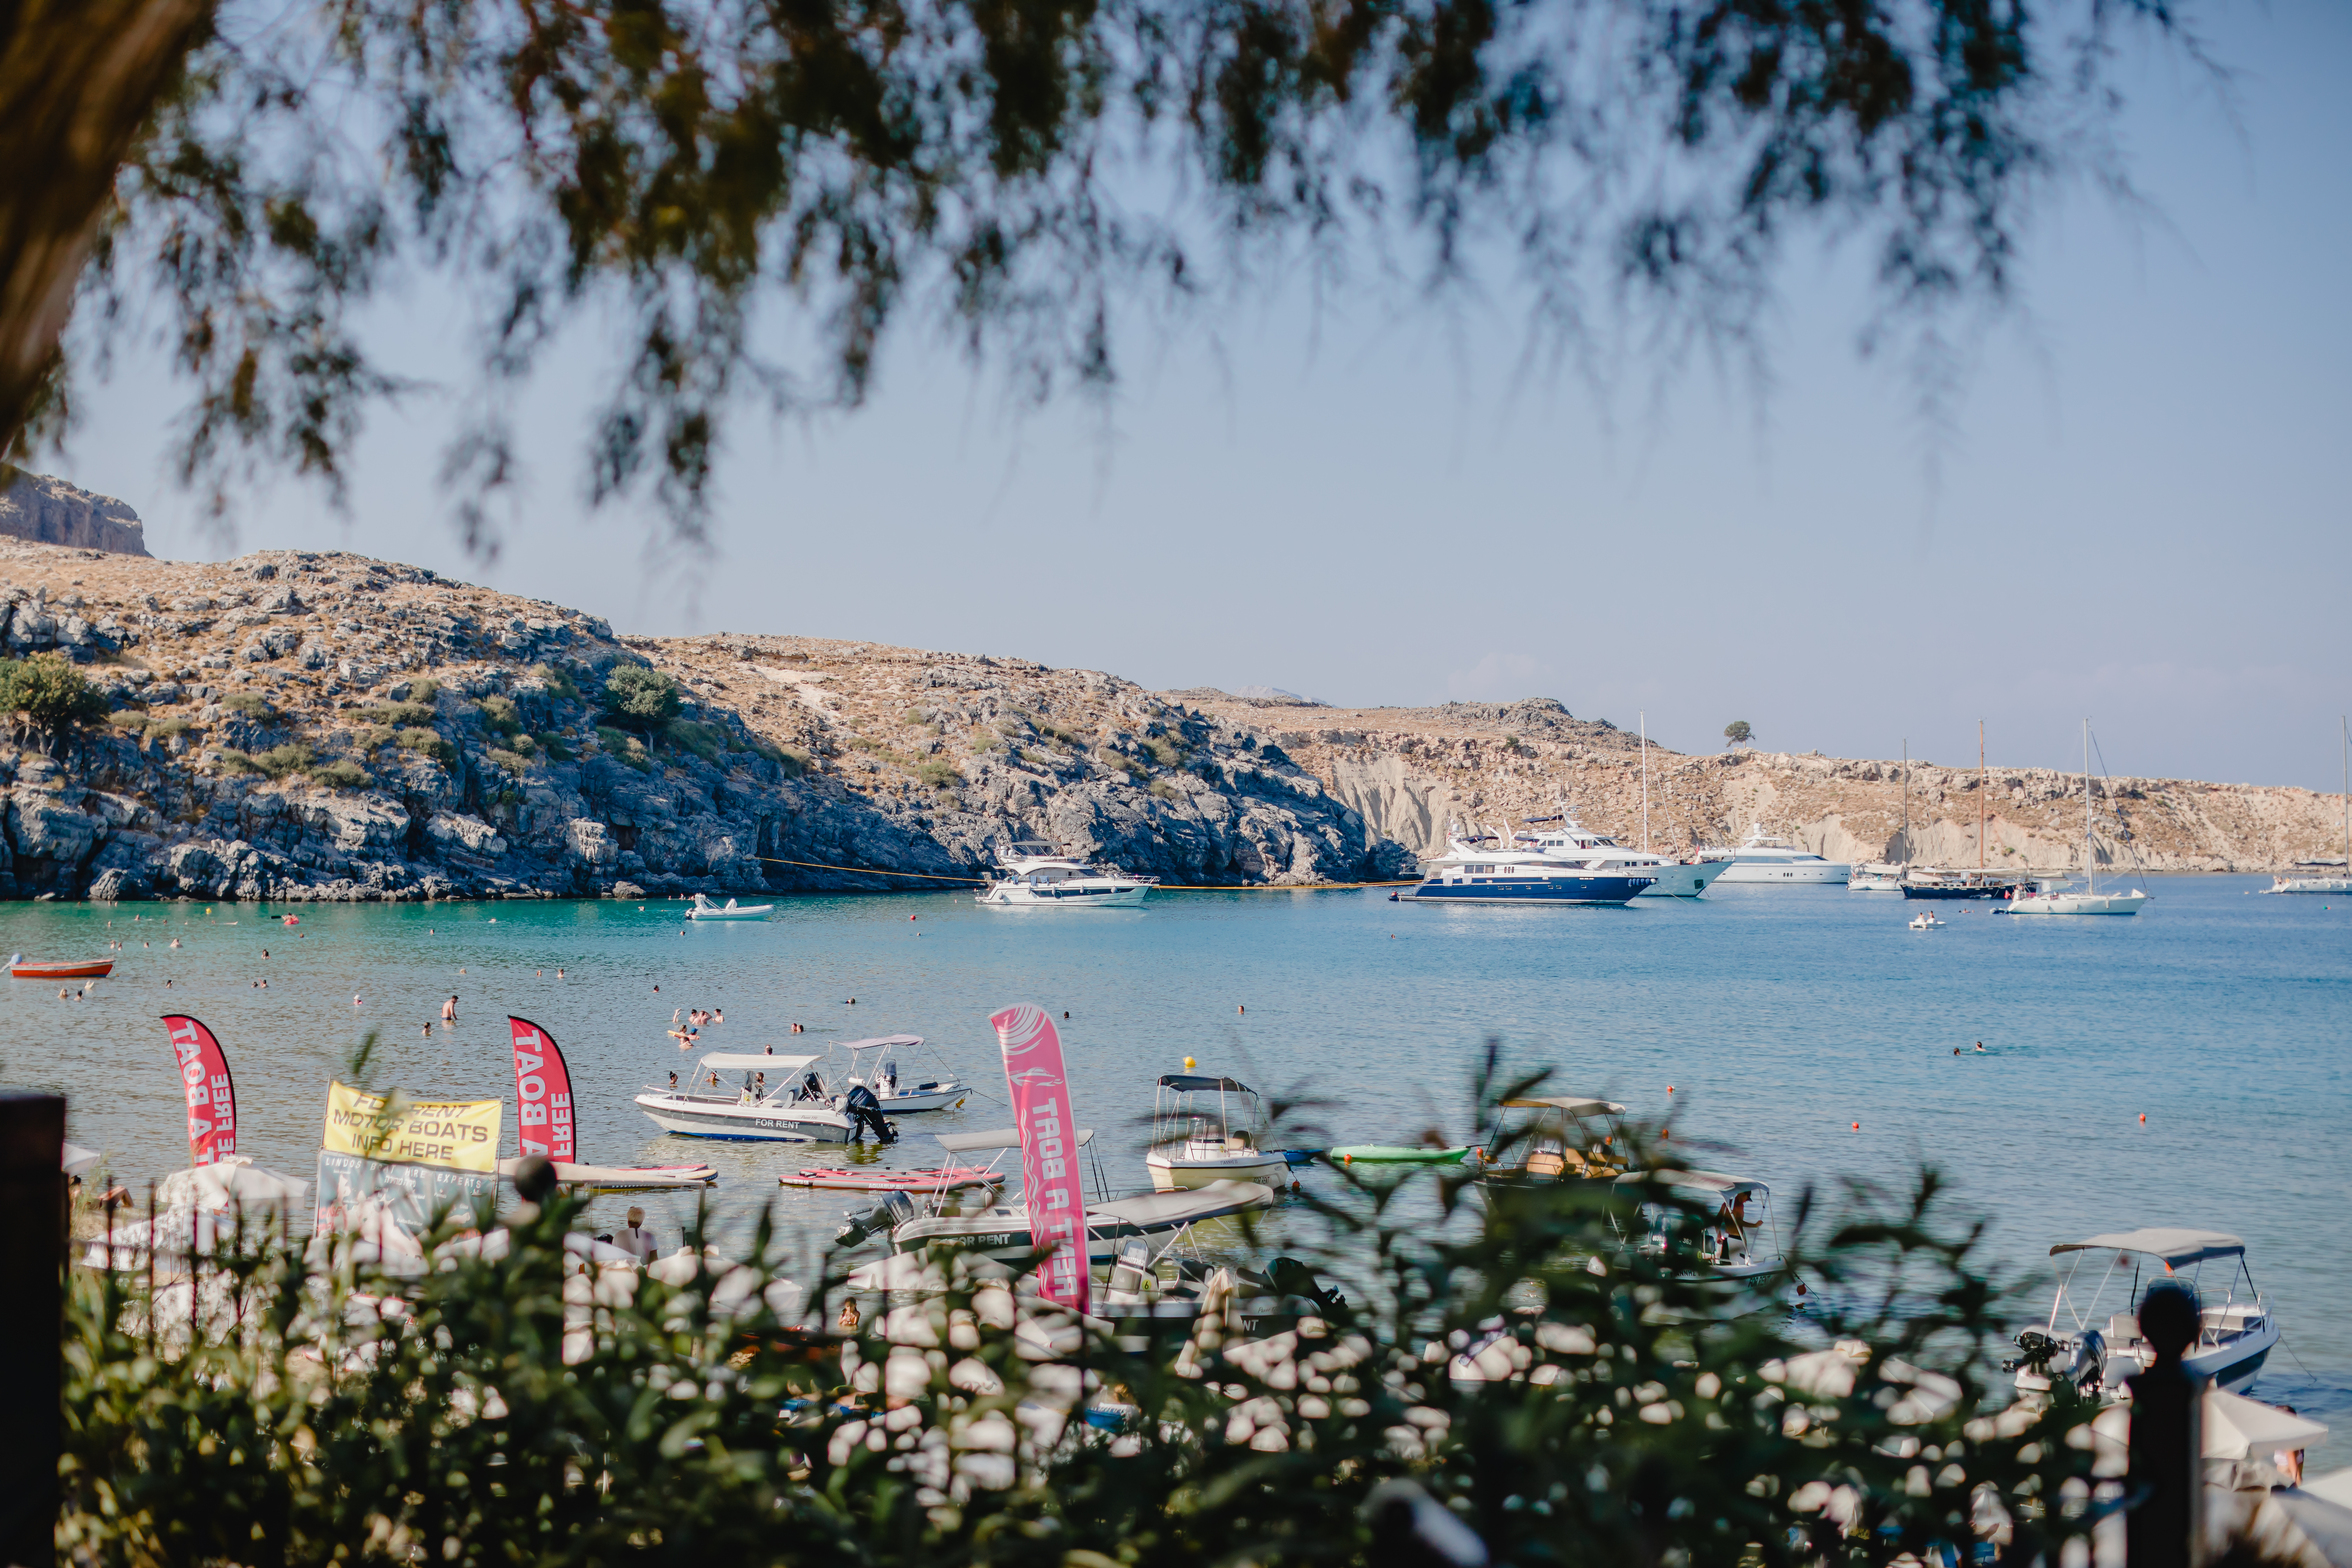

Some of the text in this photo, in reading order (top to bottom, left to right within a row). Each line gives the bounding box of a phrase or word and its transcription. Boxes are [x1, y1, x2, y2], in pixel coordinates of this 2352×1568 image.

[353, 1093, 387, 1111] FO
[333, 1109, 488, 1143] MOTOR BOATS
[755, 1118, 800, 1130] FOR RENT
[352, 1133, 454, 1160] INFO HERE
[325, 1157, 362, 1169] LINDOS
[405, 1168, 426, 1179] HIRE
[1144, 1280, 1149, 1290] 6
